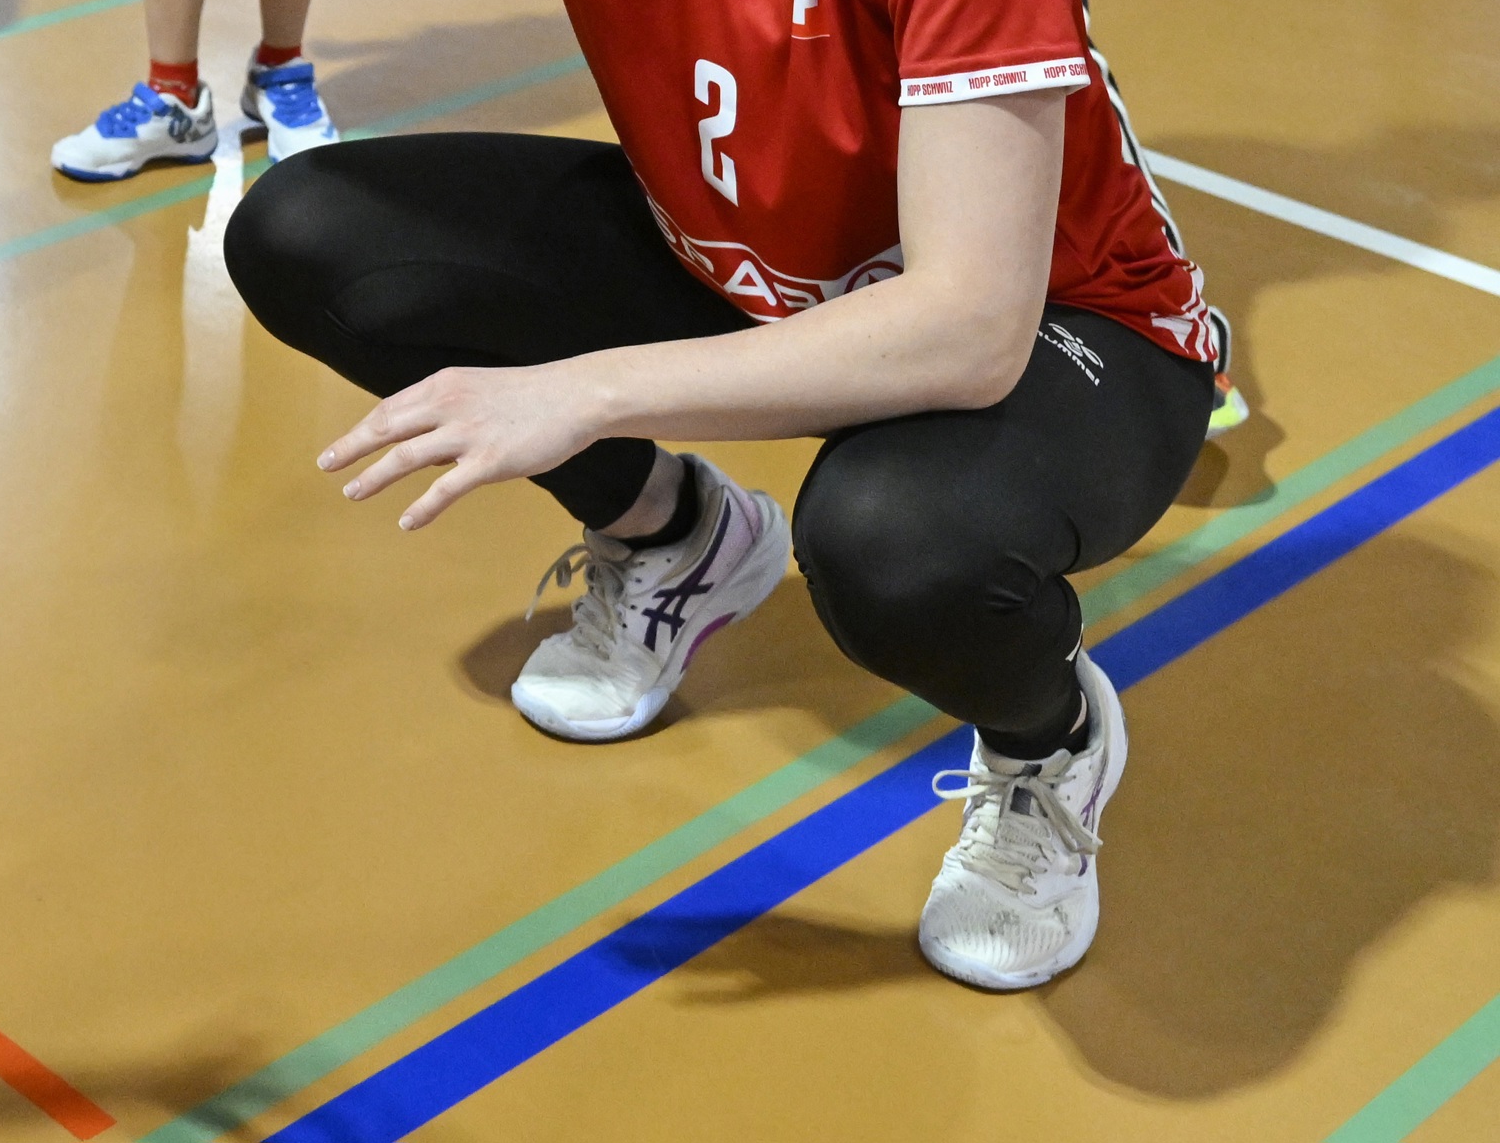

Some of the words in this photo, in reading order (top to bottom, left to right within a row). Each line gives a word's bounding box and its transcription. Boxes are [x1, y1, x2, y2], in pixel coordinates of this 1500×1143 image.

[1043, 65, 1067, 79] HOPP
[968, 75, 991, 90] HOPP
[907, 85, 921, 96] HOPP
[694, 58, 739, 207] 2
